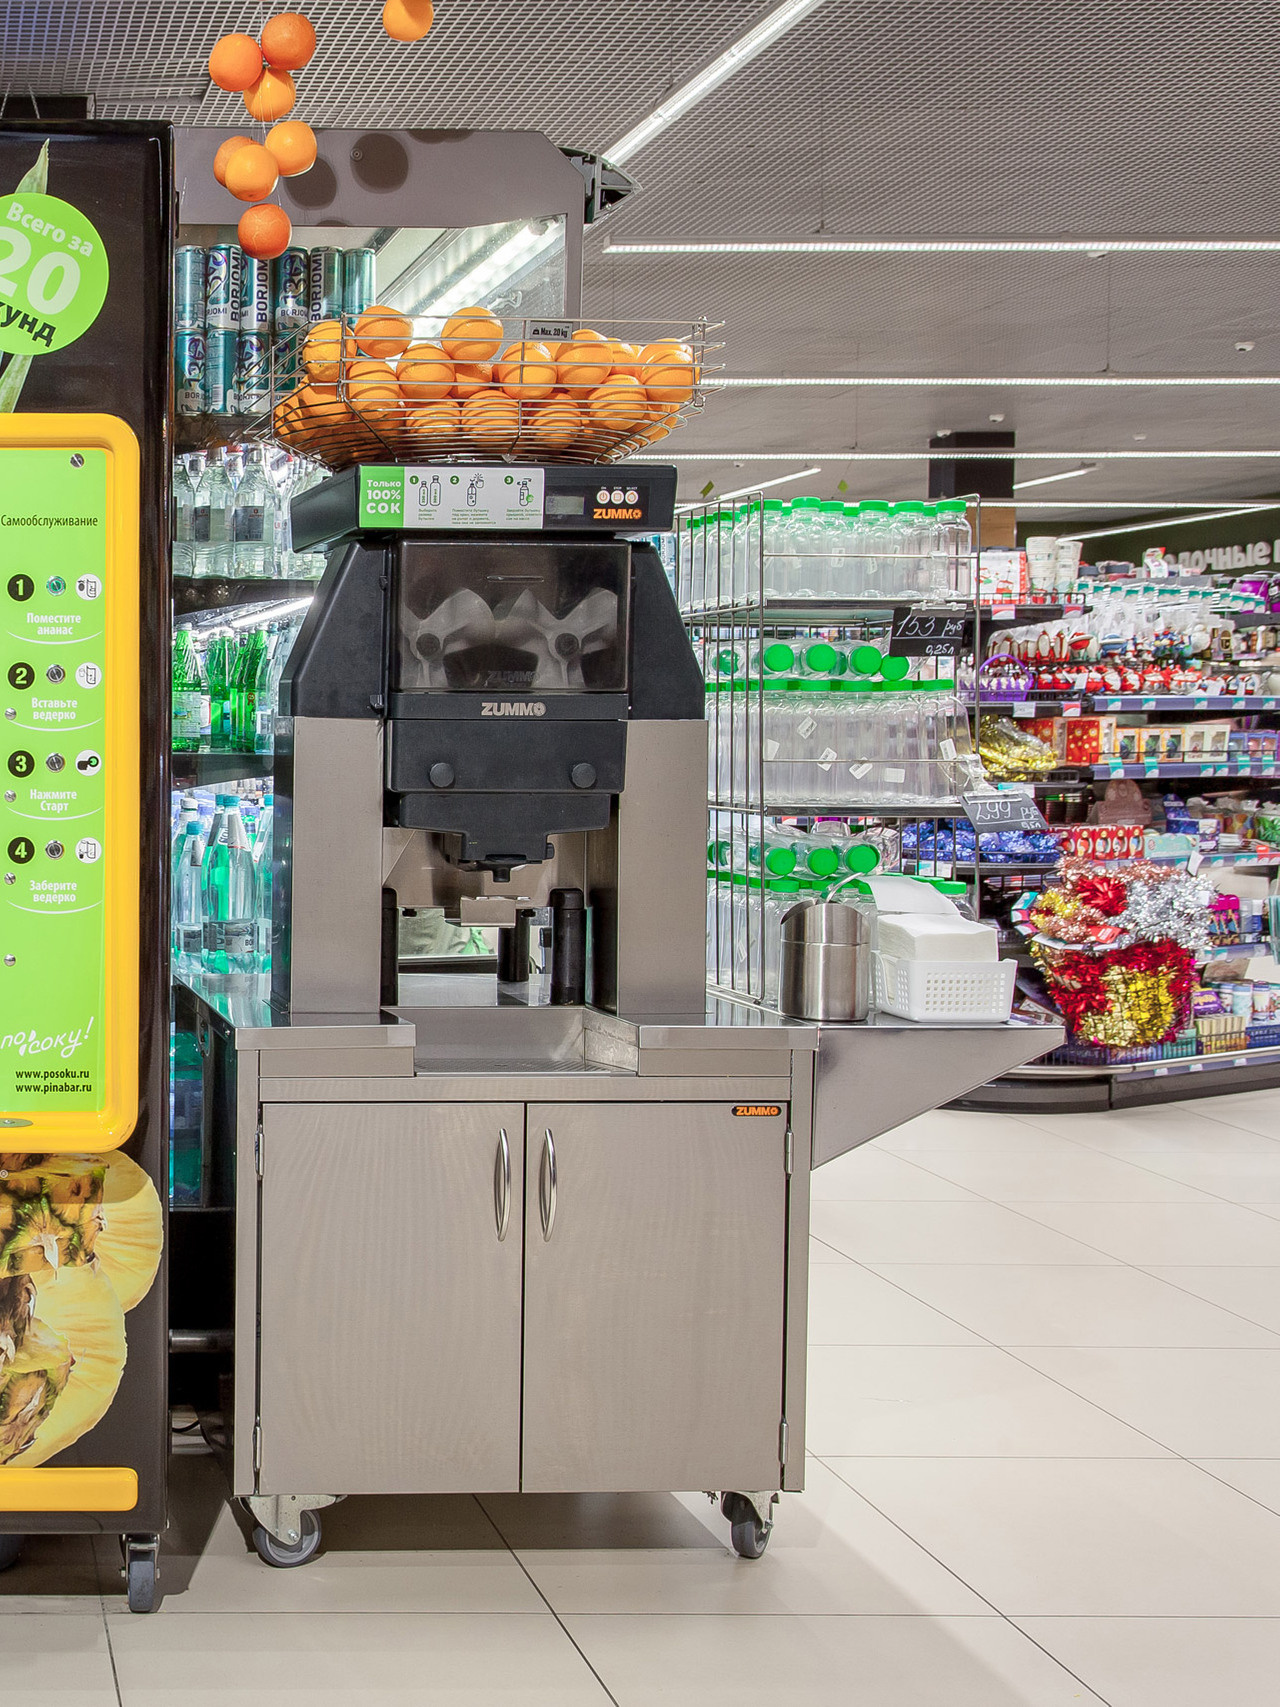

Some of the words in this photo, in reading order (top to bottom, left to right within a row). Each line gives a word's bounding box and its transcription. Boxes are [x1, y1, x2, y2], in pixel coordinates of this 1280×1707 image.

[6, 201, 66, 243] Всего
[67, 235, 94, 258] за
[256, 258, 268, 322] BORJOM
[311, 252, 322, 321] BORJOMI
[552, 328, 561, 337] 20
[561, 328, 568, 338] kg
[366, 479, 402, 487] Только
[366, 489, 402, 500] 100%
[366, 503, 401, 514] СОК
[593, 508, 642, 520] ZUMMO
[0, 514, 98, 529] Самообслуживание
[1163, 541, 1272, 573] олочные
[16, 579, 24, 596] 1
[26, 612, 82, 624] Поместите
[36, 625, 74, 636] ананас
[897, 614, 935, 637] 153
[942, 618, 966, 637] руб
[925, 644, 955, 655] 0,25л
[15, 667, 28, 685] 2
[31, 697, 78, 709] Вставьте
[481, 702, 547, 717] ZUMMO
[33, 710, 76, 722] ведерко
[15, 755, 28, 773] 3
[29, 789, 78, 801] Нажмите
[40, 801, 70, 814] Старт
[976, 801, 1011, 821] 299
[14, 841, 28, 859] 4
[29, 880, 78, 893] Заберите
[33, 893, 77, 905] ведерко
[15, 1069, 90, 1082] www.posoku.ru
[15, 1083, 93, 1095] www.pinabar.ru
[736, 1106, 780, 1116] ZUMMO
